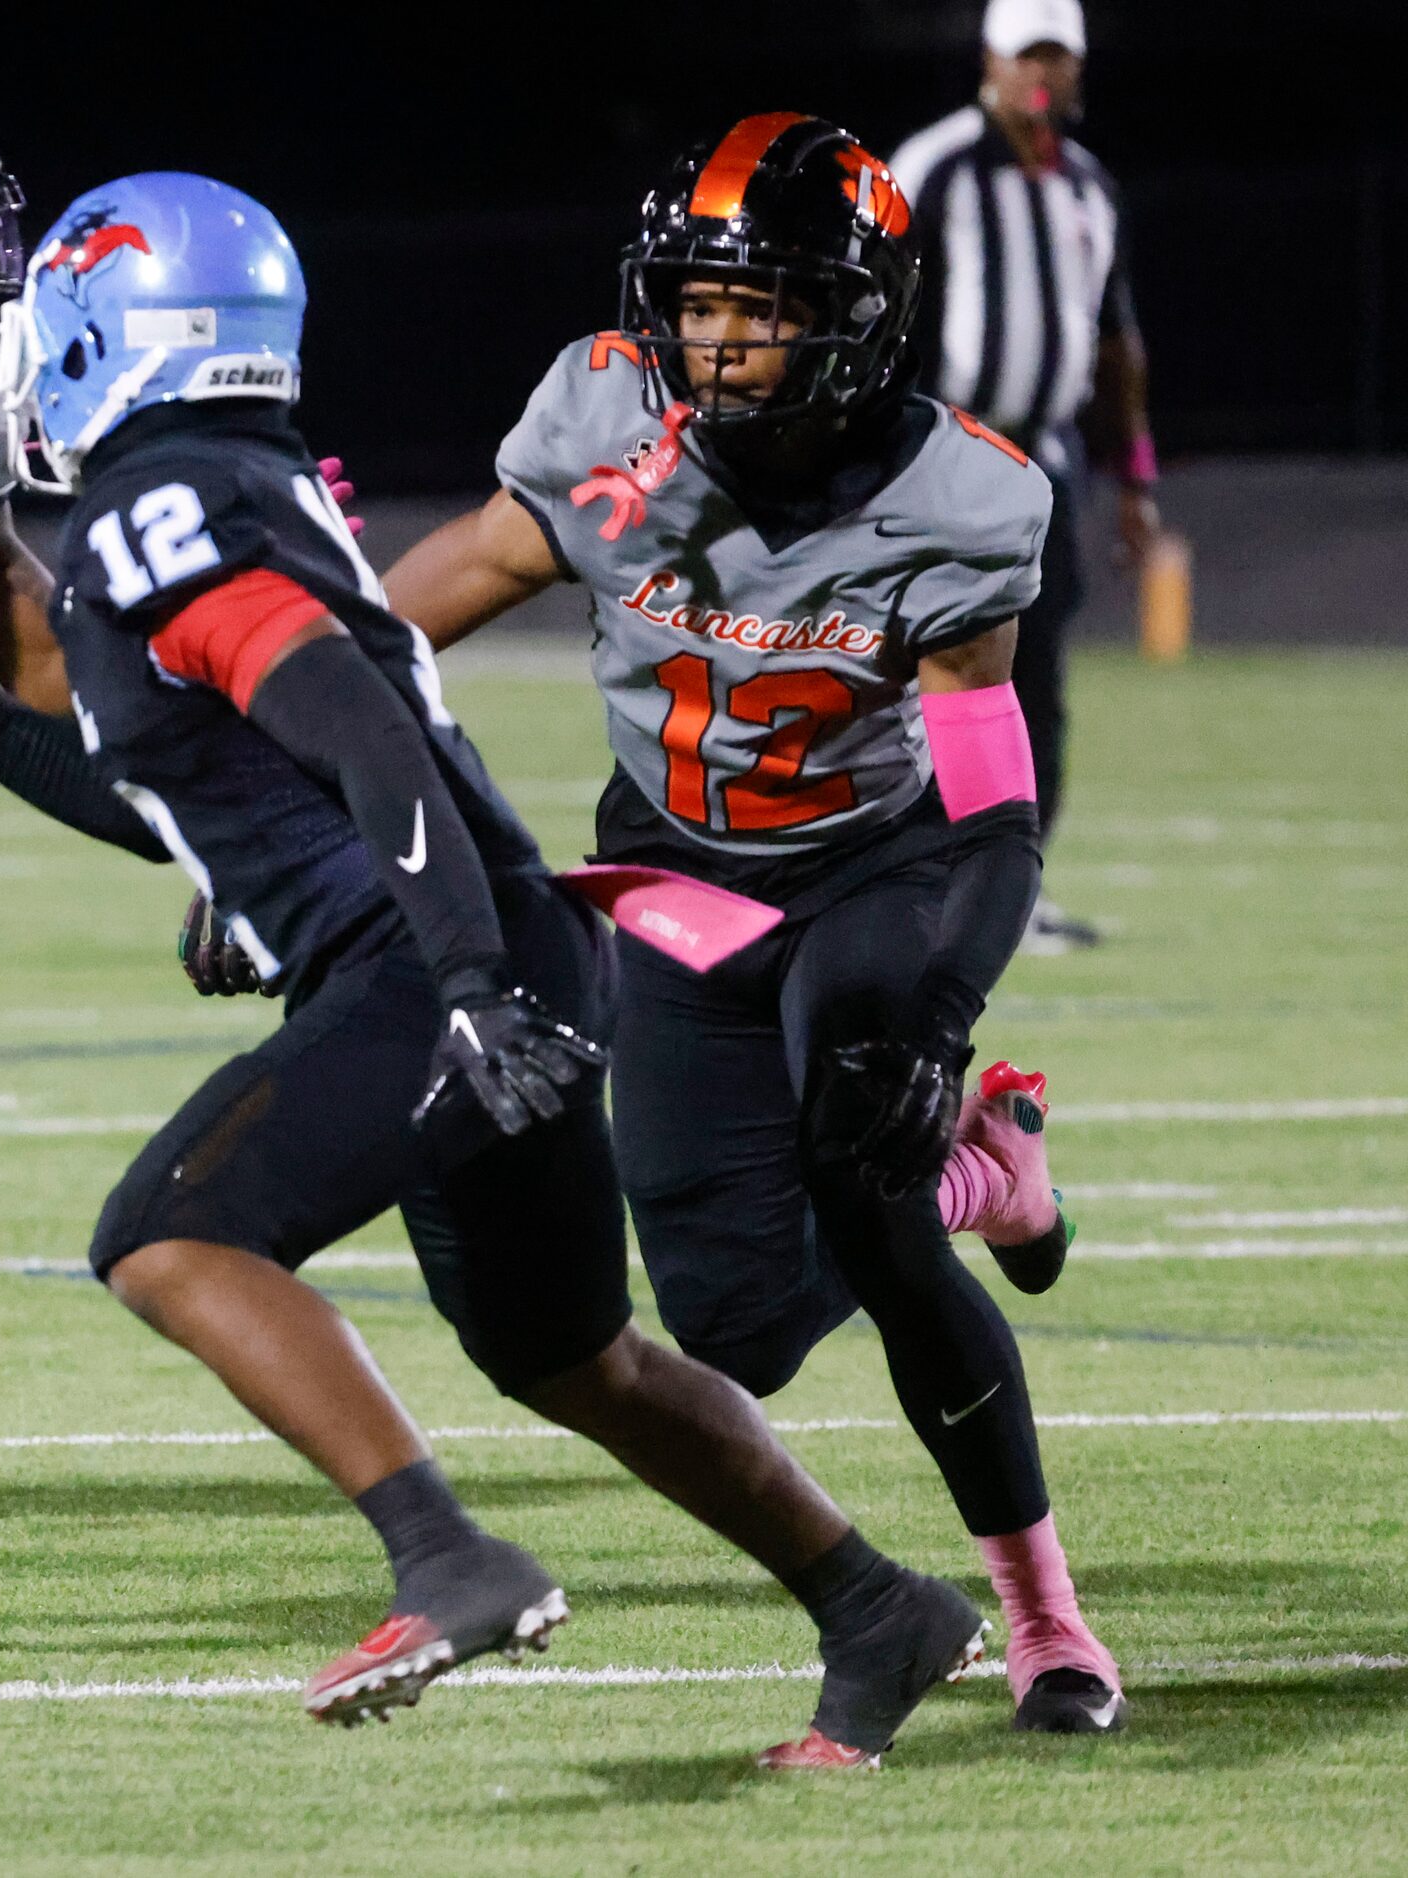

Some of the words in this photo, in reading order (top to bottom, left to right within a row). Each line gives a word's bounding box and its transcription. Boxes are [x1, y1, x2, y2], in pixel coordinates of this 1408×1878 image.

[87, 482, 223, 609] 12
[619, 570, 887, 660] Lancaster
[653, 650, 858, 831] 12
